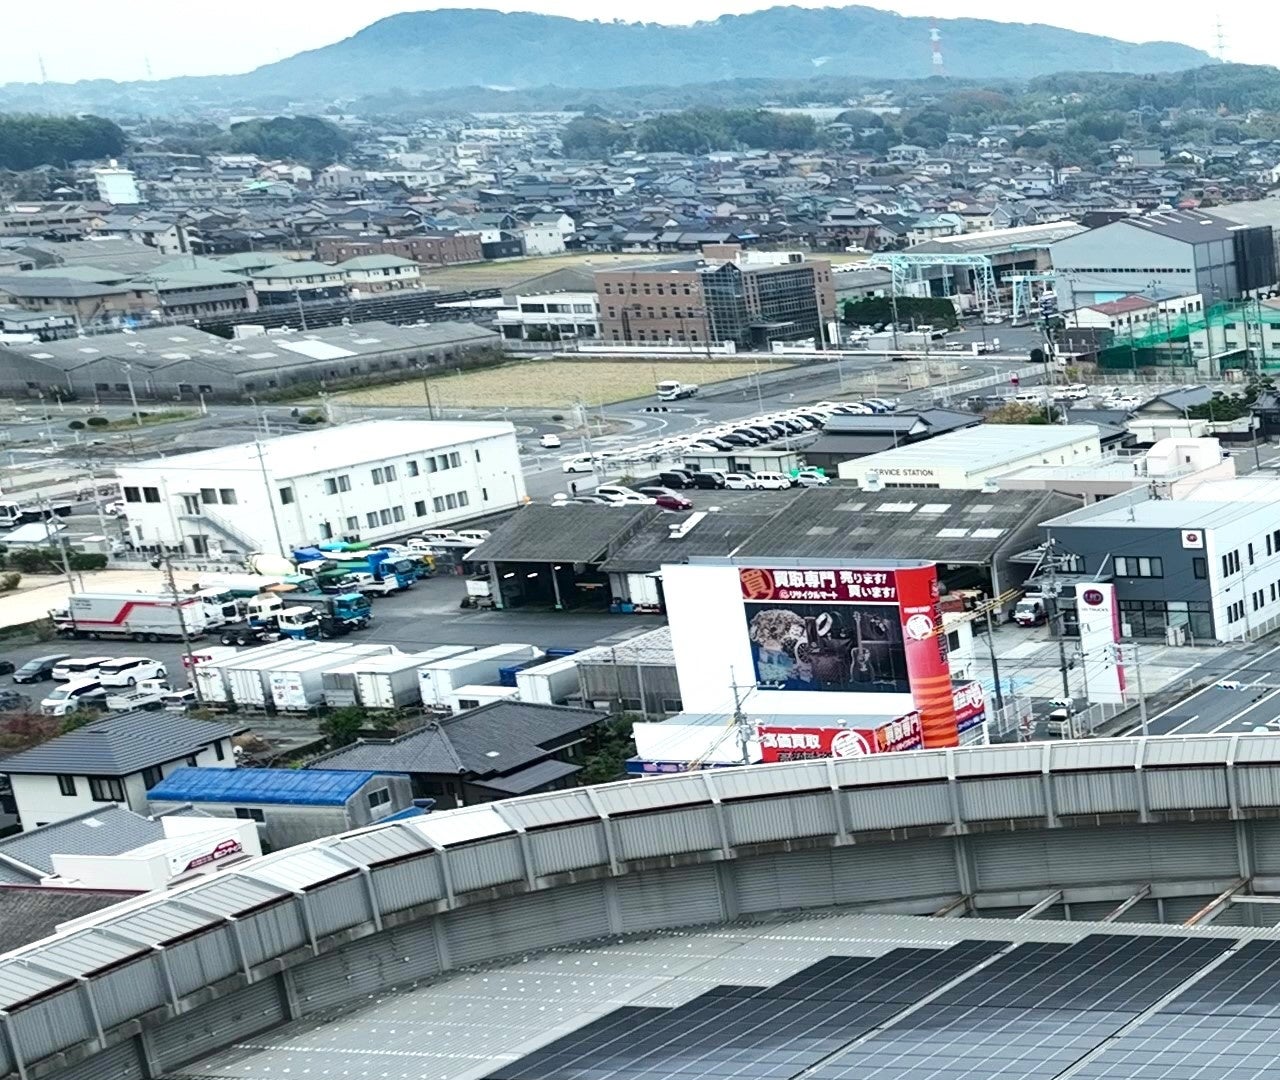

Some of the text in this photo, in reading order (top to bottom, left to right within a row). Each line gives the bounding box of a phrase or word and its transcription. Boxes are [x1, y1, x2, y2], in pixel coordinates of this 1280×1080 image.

[903, 469, 934, 477] STATION
[773, 571, 836, 588] 買取専門
